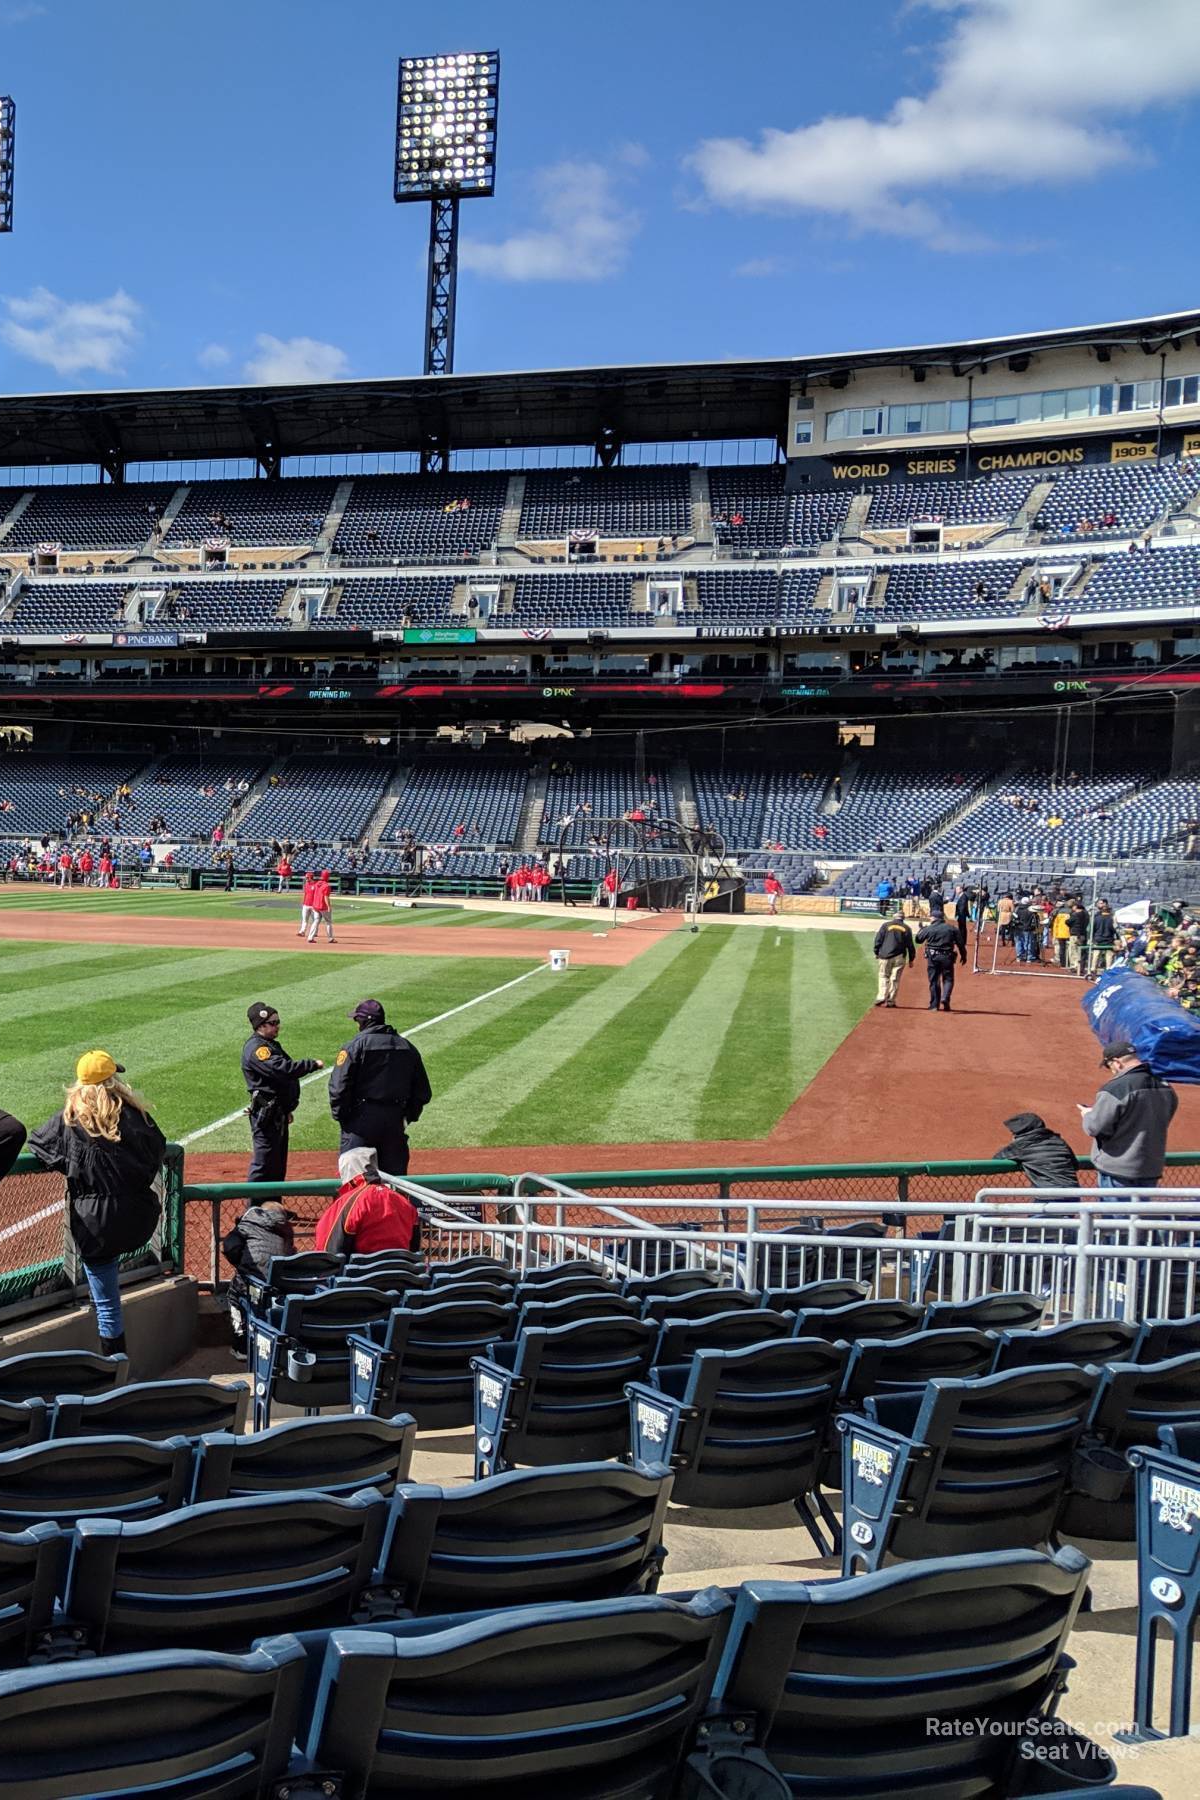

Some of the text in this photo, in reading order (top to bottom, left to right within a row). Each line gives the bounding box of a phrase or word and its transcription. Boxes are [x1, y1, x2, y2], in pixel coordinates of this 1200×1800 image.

[1115, 446, 1147, 458] 1909
[833, 447, 1084, 479] WORLD SERIES CHAMPIONS
[702, 627, 765, 637] RIVENDALE
[781, 625, 869, 635] SUITE LEVEL
[128, 635, 174, 644] PNC BANK
[1066, 680, 1091, 690] PNC
[309, 690, 338, 699] OPENING
[553, 687, 576, 697] PNC
[852, 1439, 892, 1475] PIRATES
[856, 1525, 868, 1540] H
[1159, 1581, 1173, 1597] J
